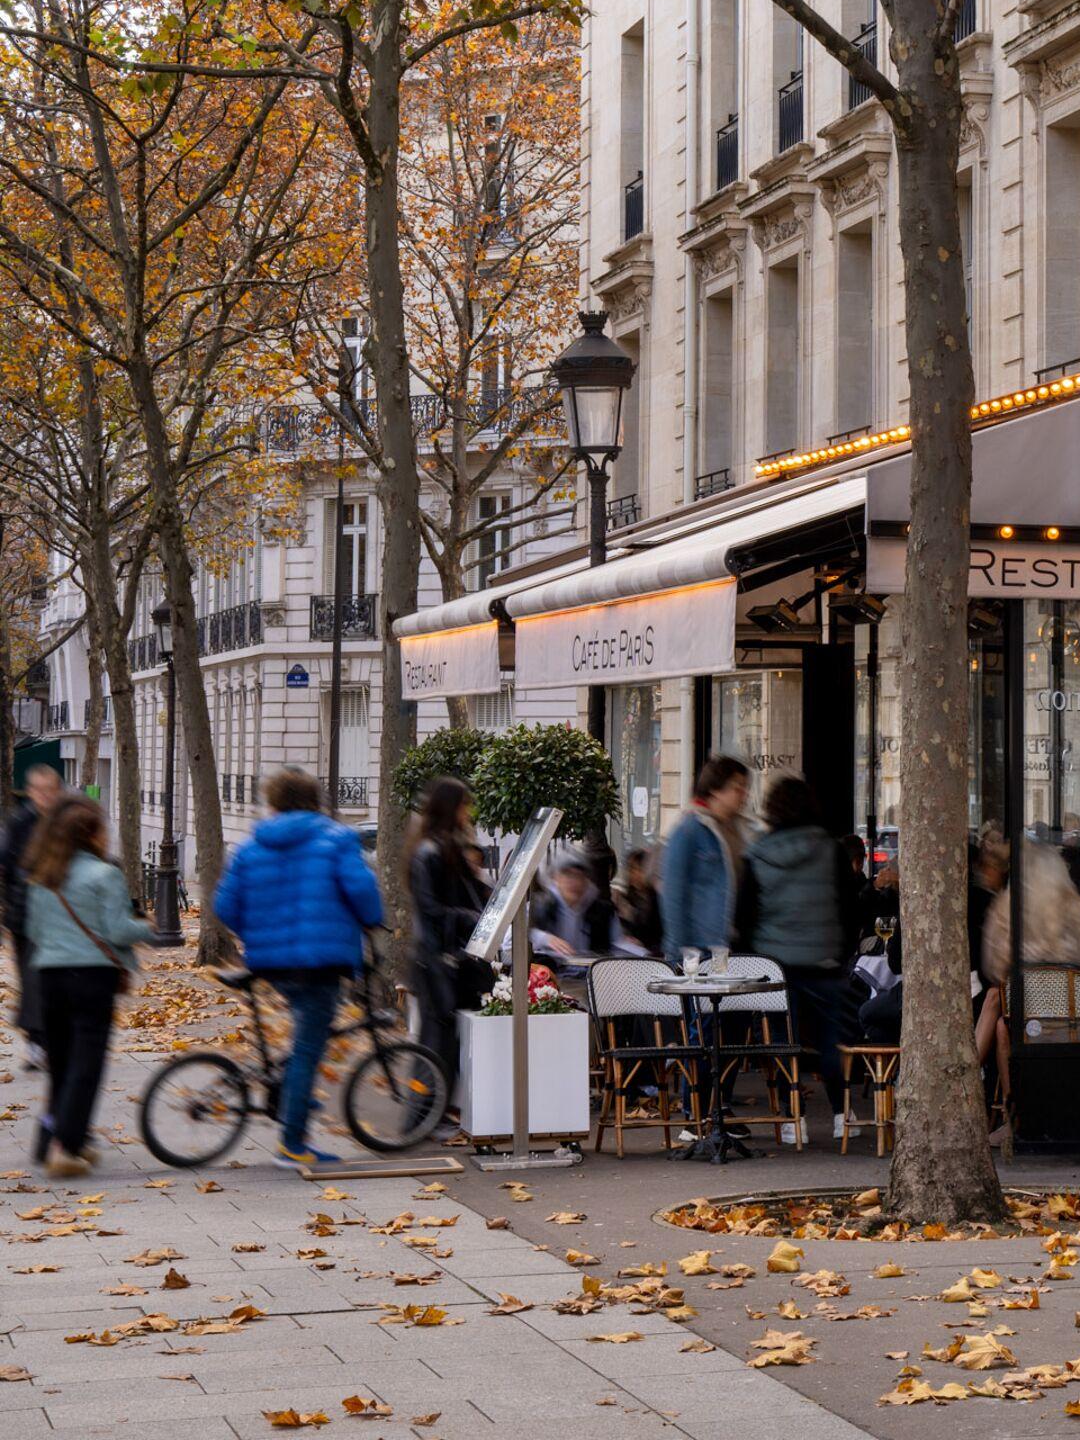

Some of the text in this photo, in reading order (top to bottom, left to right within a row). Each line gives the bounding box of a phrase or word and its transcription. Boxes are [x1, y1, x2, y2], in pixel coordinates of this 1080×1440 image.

[572, 625, 655, 672] CAFÉ DE PARIS
